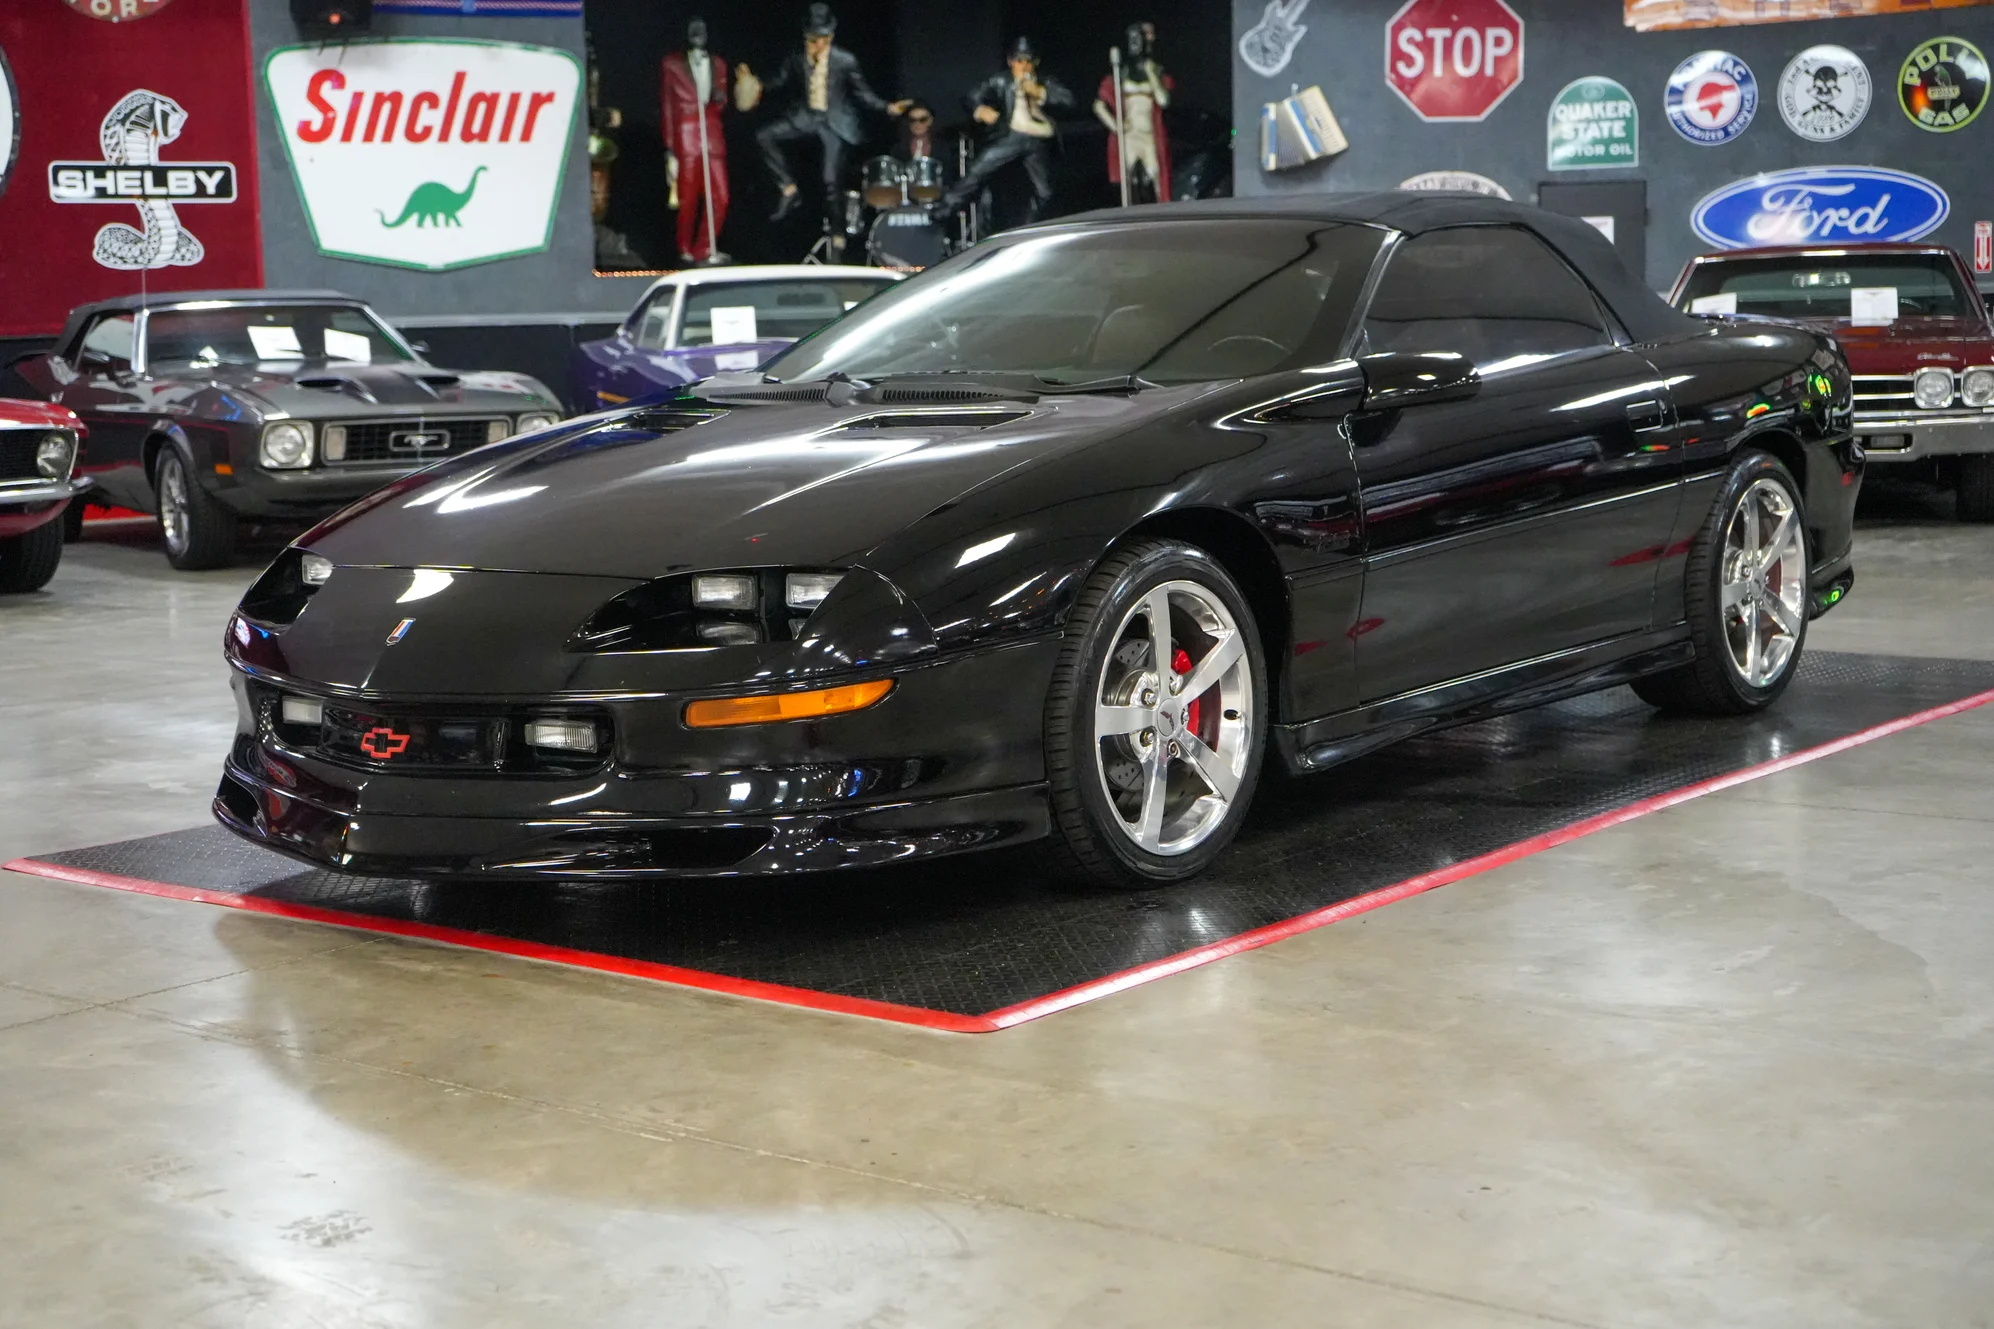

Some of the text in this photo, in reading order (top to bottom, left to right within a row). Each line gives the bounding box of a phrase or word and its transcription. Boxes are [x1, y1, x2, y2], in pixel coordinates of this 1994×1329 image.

[1395, 26, 1514, 79] STOP
[297, 68, 556, 144] Sinclair
[1554, 100, 1633, 123] QUAKER
[1918, 102, 1971, 127] GAS
[1561, 119, 1627, 140] STATE
[1608, 143, 1634, 156] OIL
[56, 169, 226, 196] SHELBY
[1746, 182, 1892, 241] Ford
